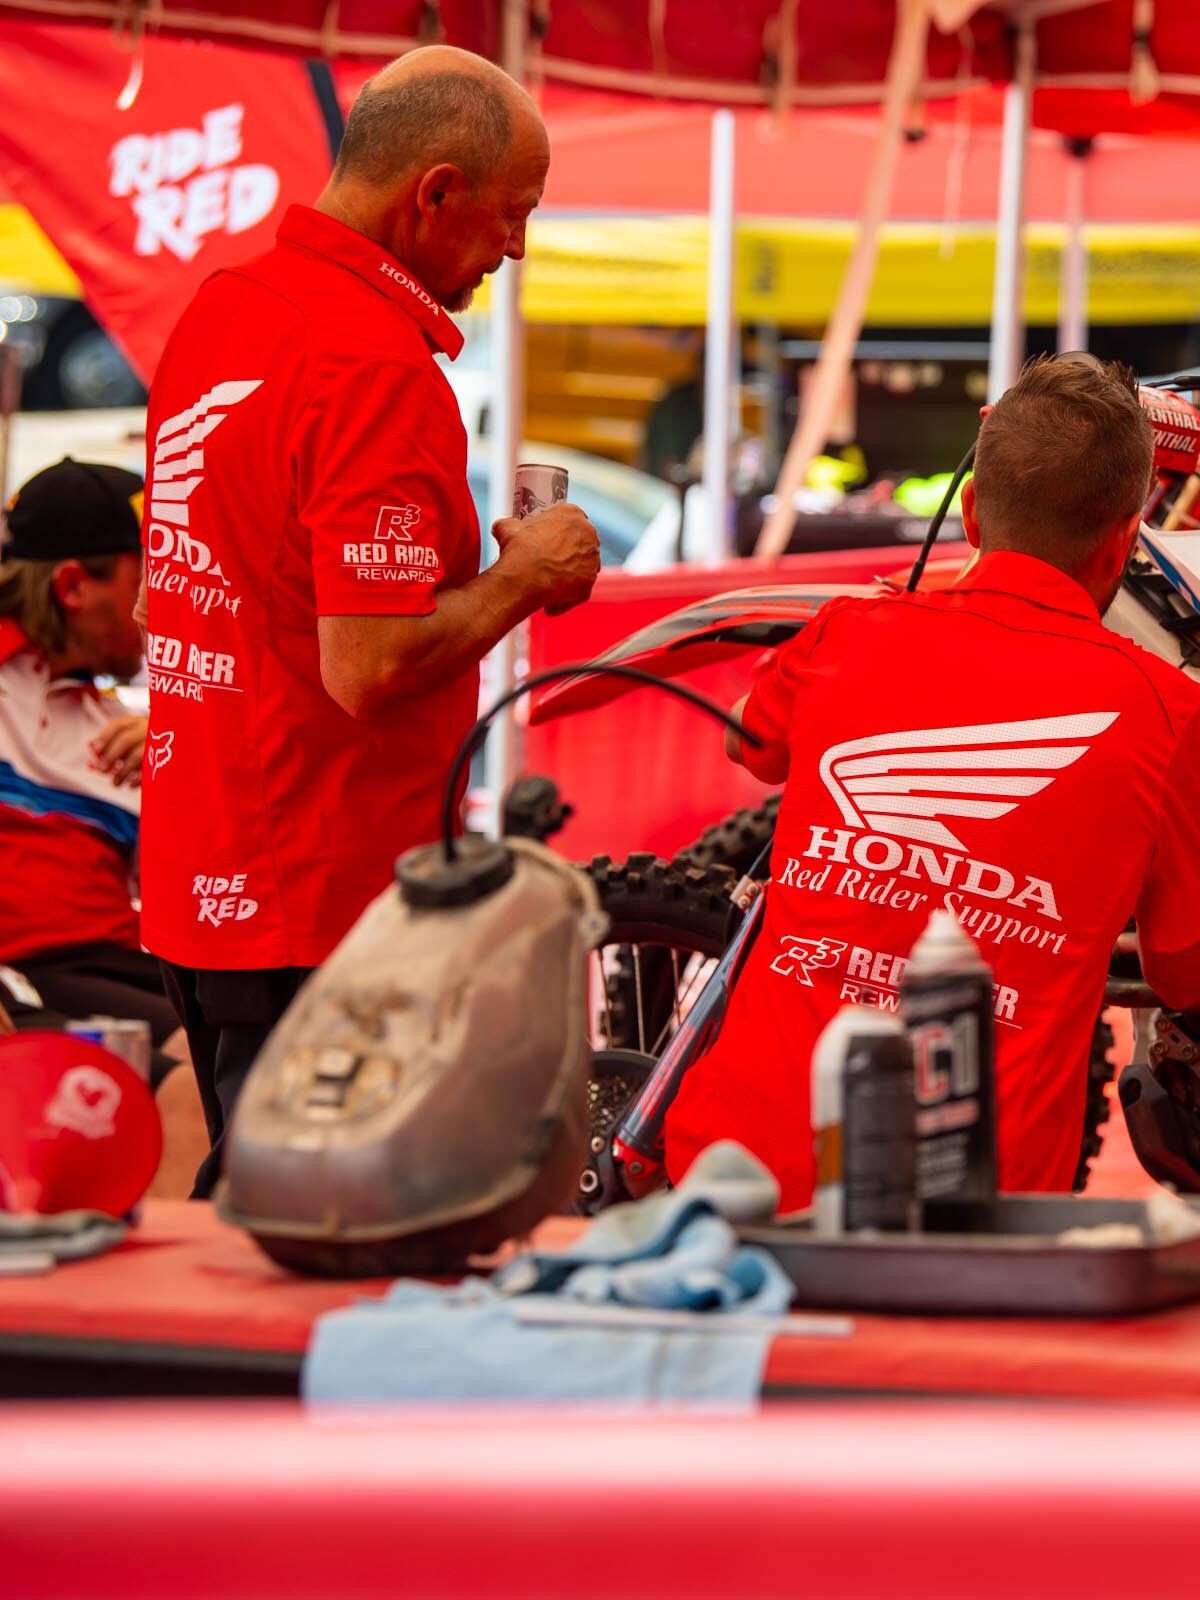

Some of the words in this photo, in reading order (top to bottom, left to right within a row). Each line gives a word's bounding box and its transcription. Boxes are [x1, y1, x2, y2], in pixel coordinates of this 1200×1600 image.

[109, 103, 245, 197] RIDE
[132, 163, 280, 263] RED
[379, 261, 439, 317] HONDA
[1152, 428, 1197, 453] NTHAL
[148, 522, 231, 586] ONDA
[344, 543, 387, 563] RED
[395, 544, 439, 568] RIDER
[147, 559, 189, 595] ider
[357, 568, 436, 583] REWARDS
[187, 643, 235, 685] RER
[192, 873, 248, 898] RIDE
[802, 825, 1063, 922] HONDA
[197, 896, 259, 928] RED
[777, 857, 833, 892] Red
[834, 868, 928, 912] Rider
[943, 891, 1068, 955] Support
